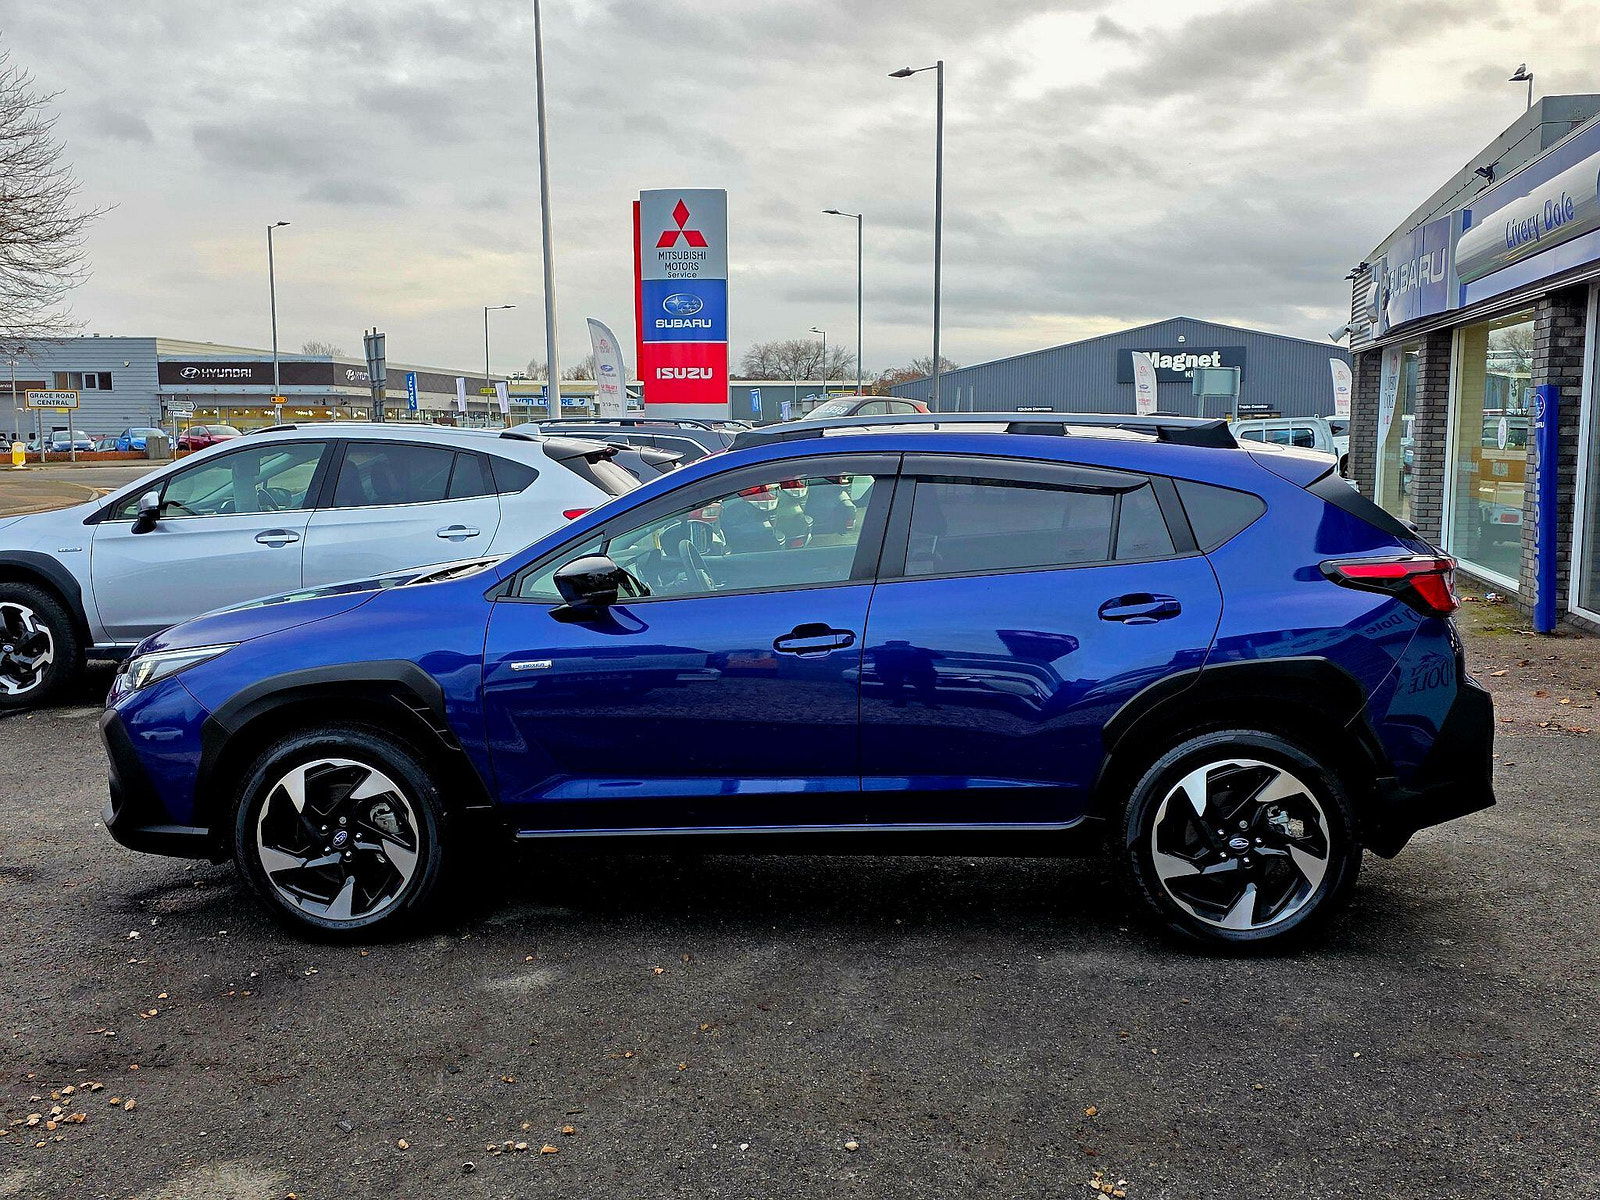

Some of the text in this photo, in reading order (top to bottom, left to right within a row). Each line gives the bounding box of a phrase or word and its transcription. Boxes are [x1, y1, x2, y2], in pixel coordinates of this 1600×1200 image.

[1506, 191, 1574, 249] Livery Dole
[658, 251, 707, 260] MITSUBISHI
[664, 262, 700, 271] MOTORS
[667, 271, 697, 279] Service
[655, 319, 712, 329] SUBARU
[1143, 350, 1221, 372] Magnet
[201, 368, 252, 378] HYUNDAI
[656, 367, 713, 380] ISUZU
